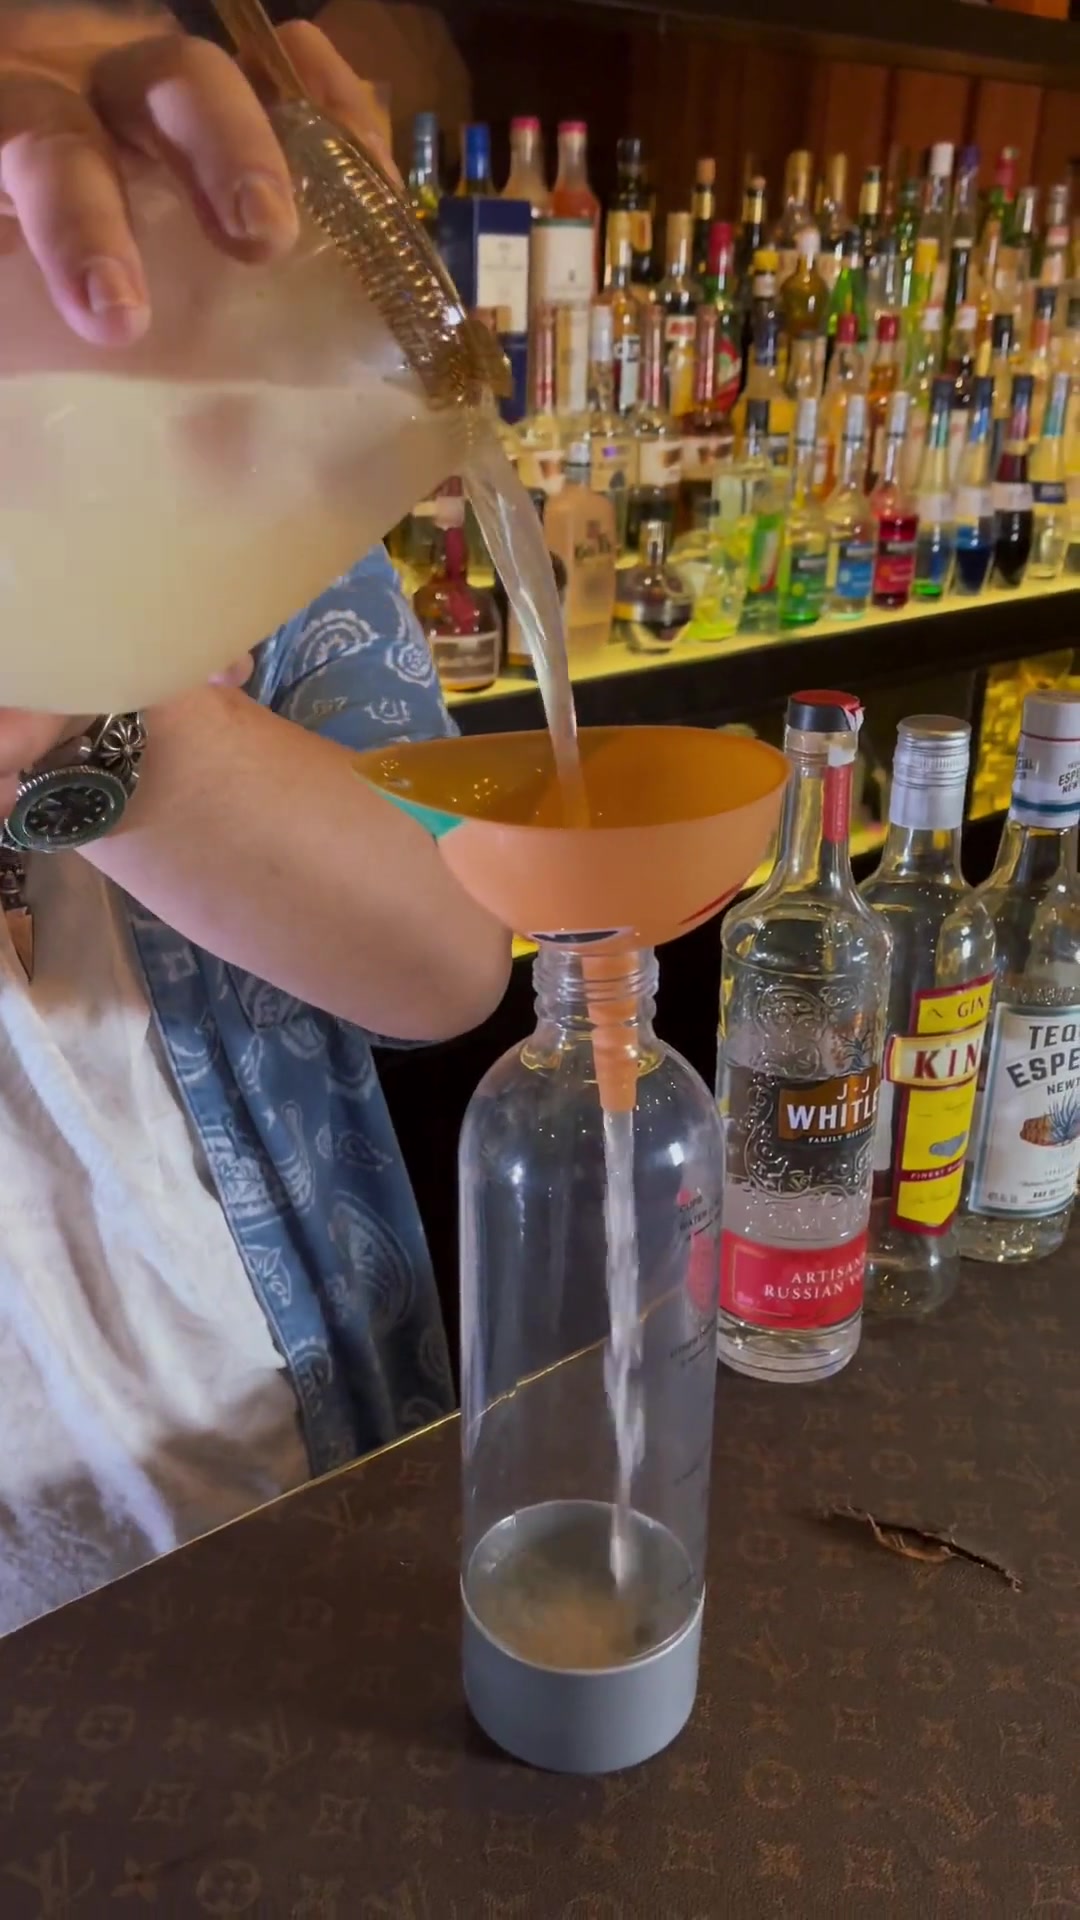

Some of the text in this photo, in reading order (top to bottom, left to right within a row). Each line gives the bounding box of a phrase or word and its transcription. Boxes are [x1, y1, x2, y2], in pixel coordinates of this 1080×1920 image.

[957, 996, 984, 1018] GIN
[1006, 1047, 1080, 1089] ESPE
[808, 1135, 843, 1144] FAMILY
[910, 1168, 944, 1180] FINEST
[764, 1281, 843, 1300] RUSSIAN
